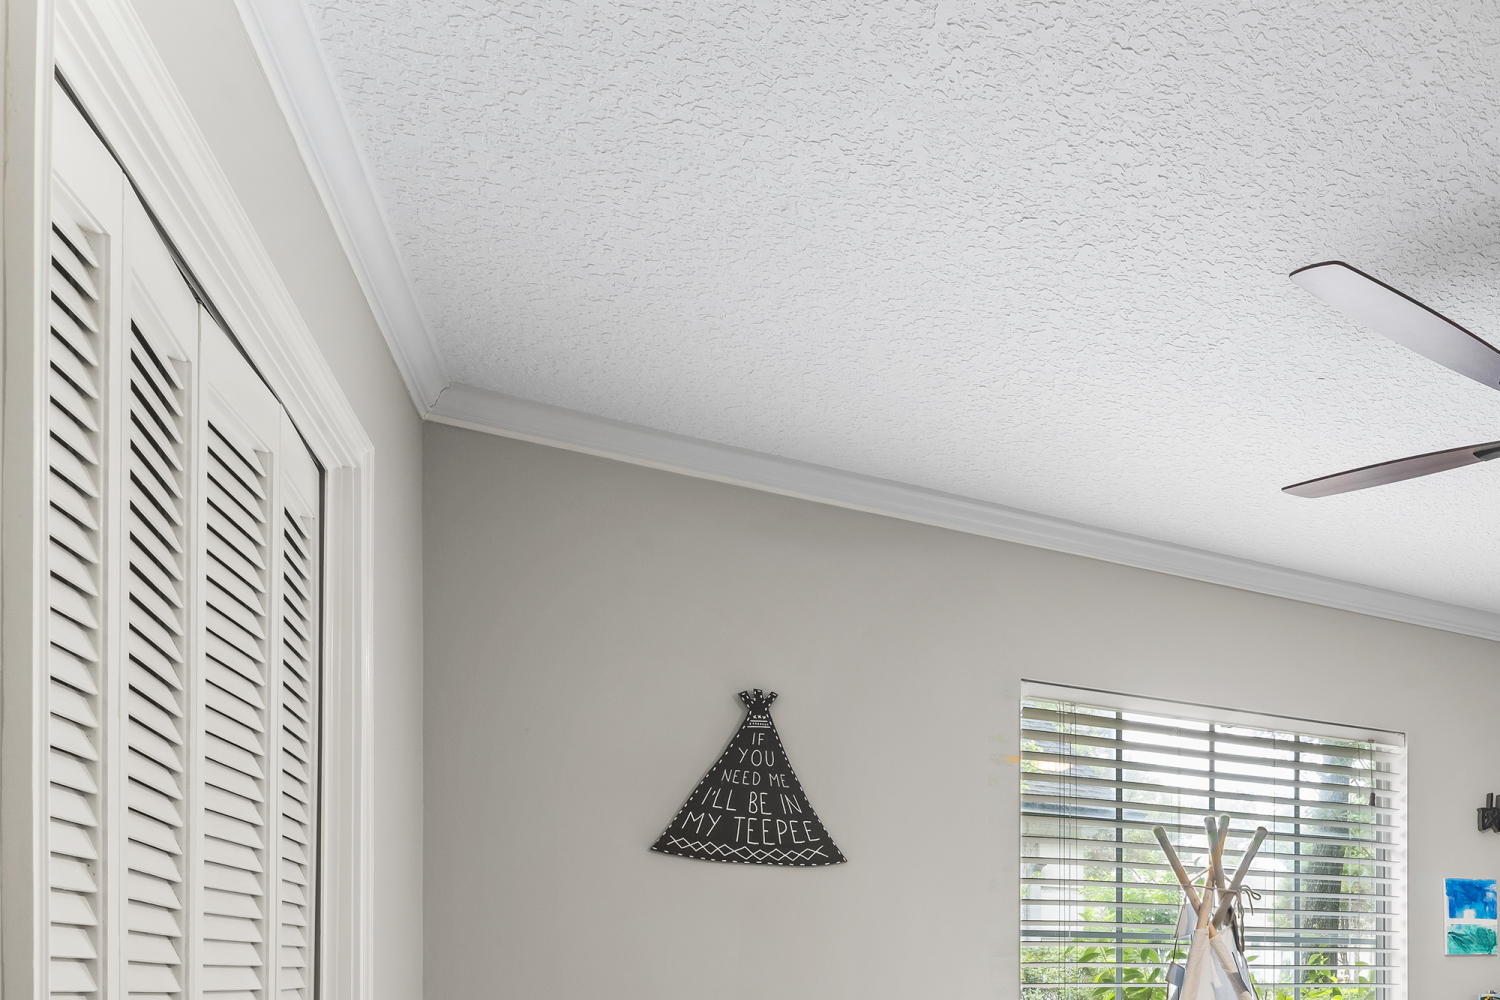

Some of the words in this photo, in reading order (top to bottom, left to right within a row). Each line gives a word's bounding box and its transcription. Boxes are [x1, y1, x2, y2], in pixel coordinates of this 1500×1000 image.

[752, 732, 765, 745] IF
[738, 747, 775, 766] YOU
[721, 769, 761, 786] NEED
[768, 773, 790, 788] ME
[701, 787, 737, 811] I'LL
[748, 791, 772, 816] BE
[780, 793, 803, 815] IN
[681, 811, 722, 837] MY
[733, 815, 821, 846] TEEPEE
